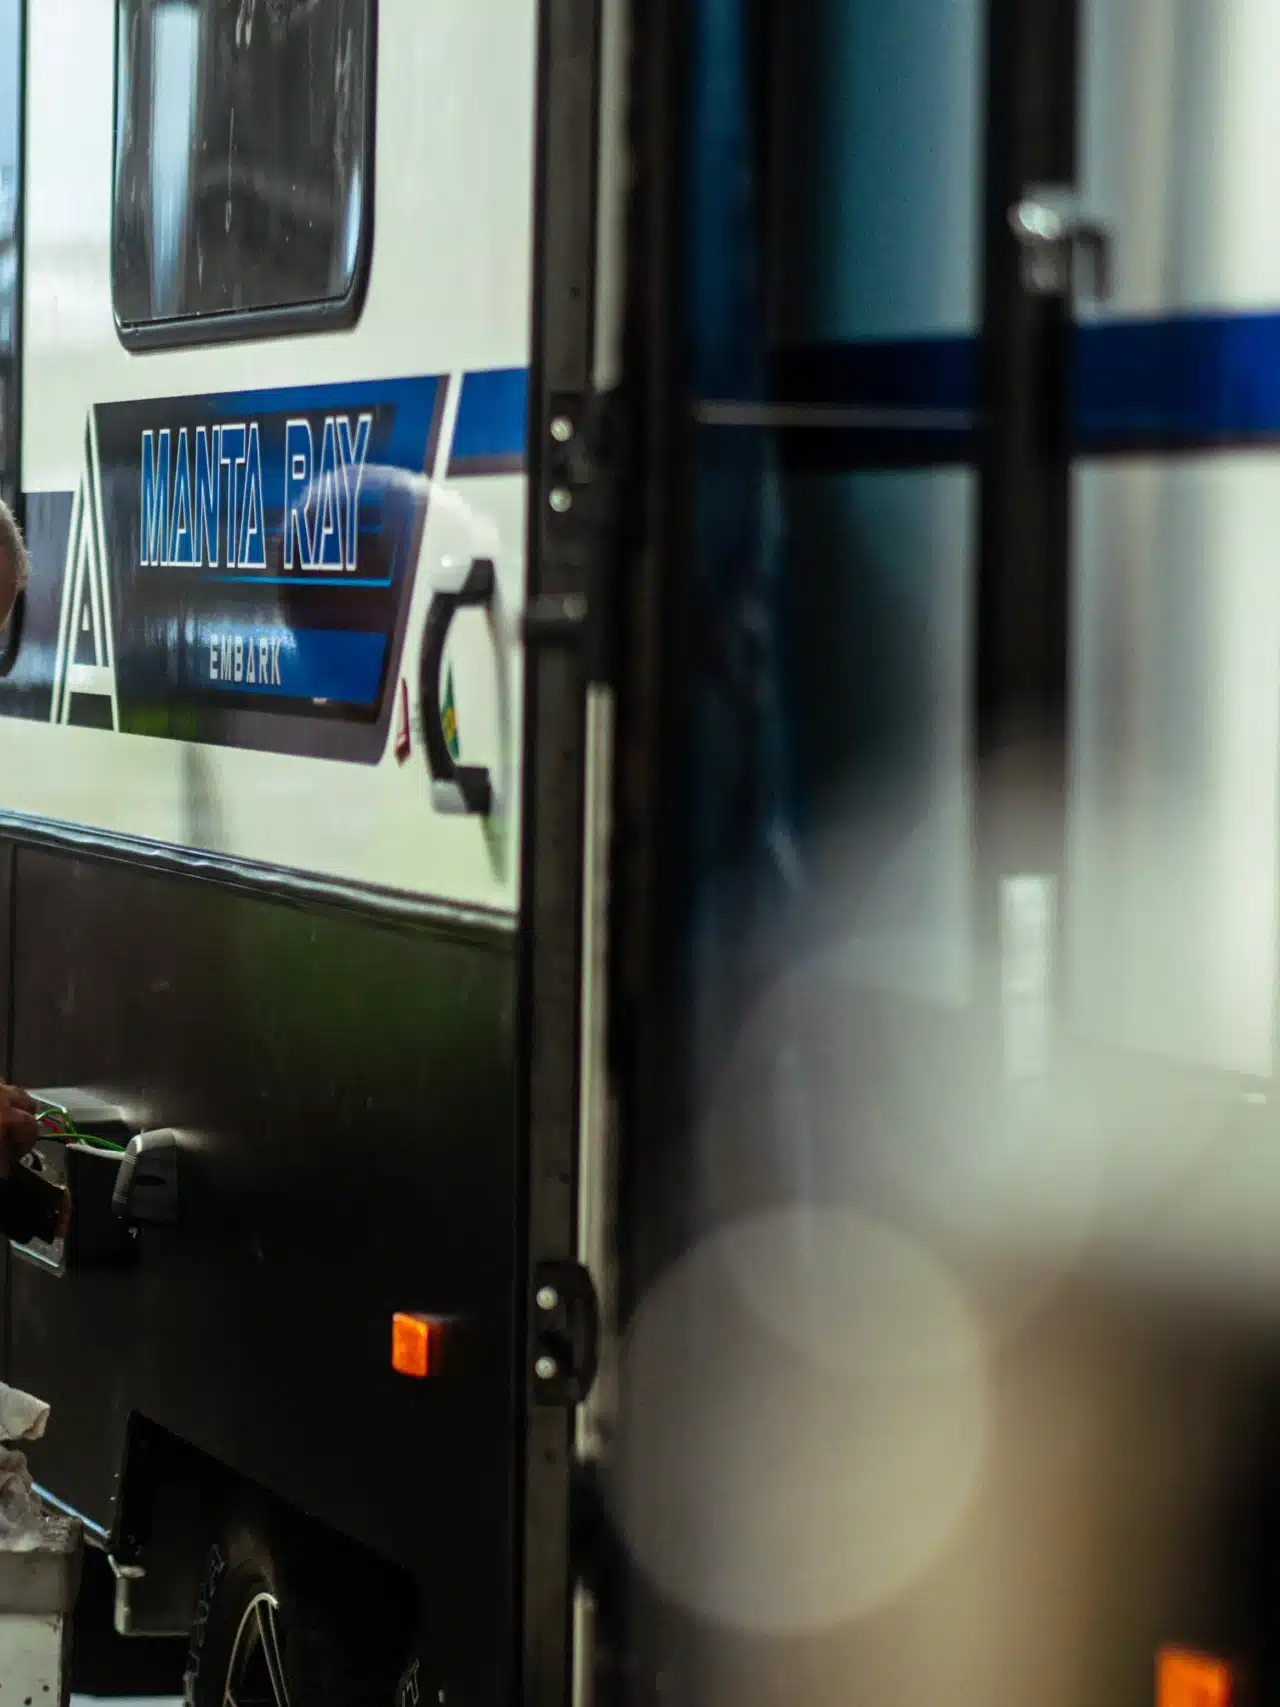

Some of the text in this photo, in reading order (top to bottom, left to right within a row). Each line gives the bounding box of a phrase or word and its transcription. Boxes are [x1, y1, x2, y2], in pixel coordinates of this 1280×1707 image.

[140, 413, 373, 571] MANTA RAY
[209, 633, 281, 686] EMBARK
